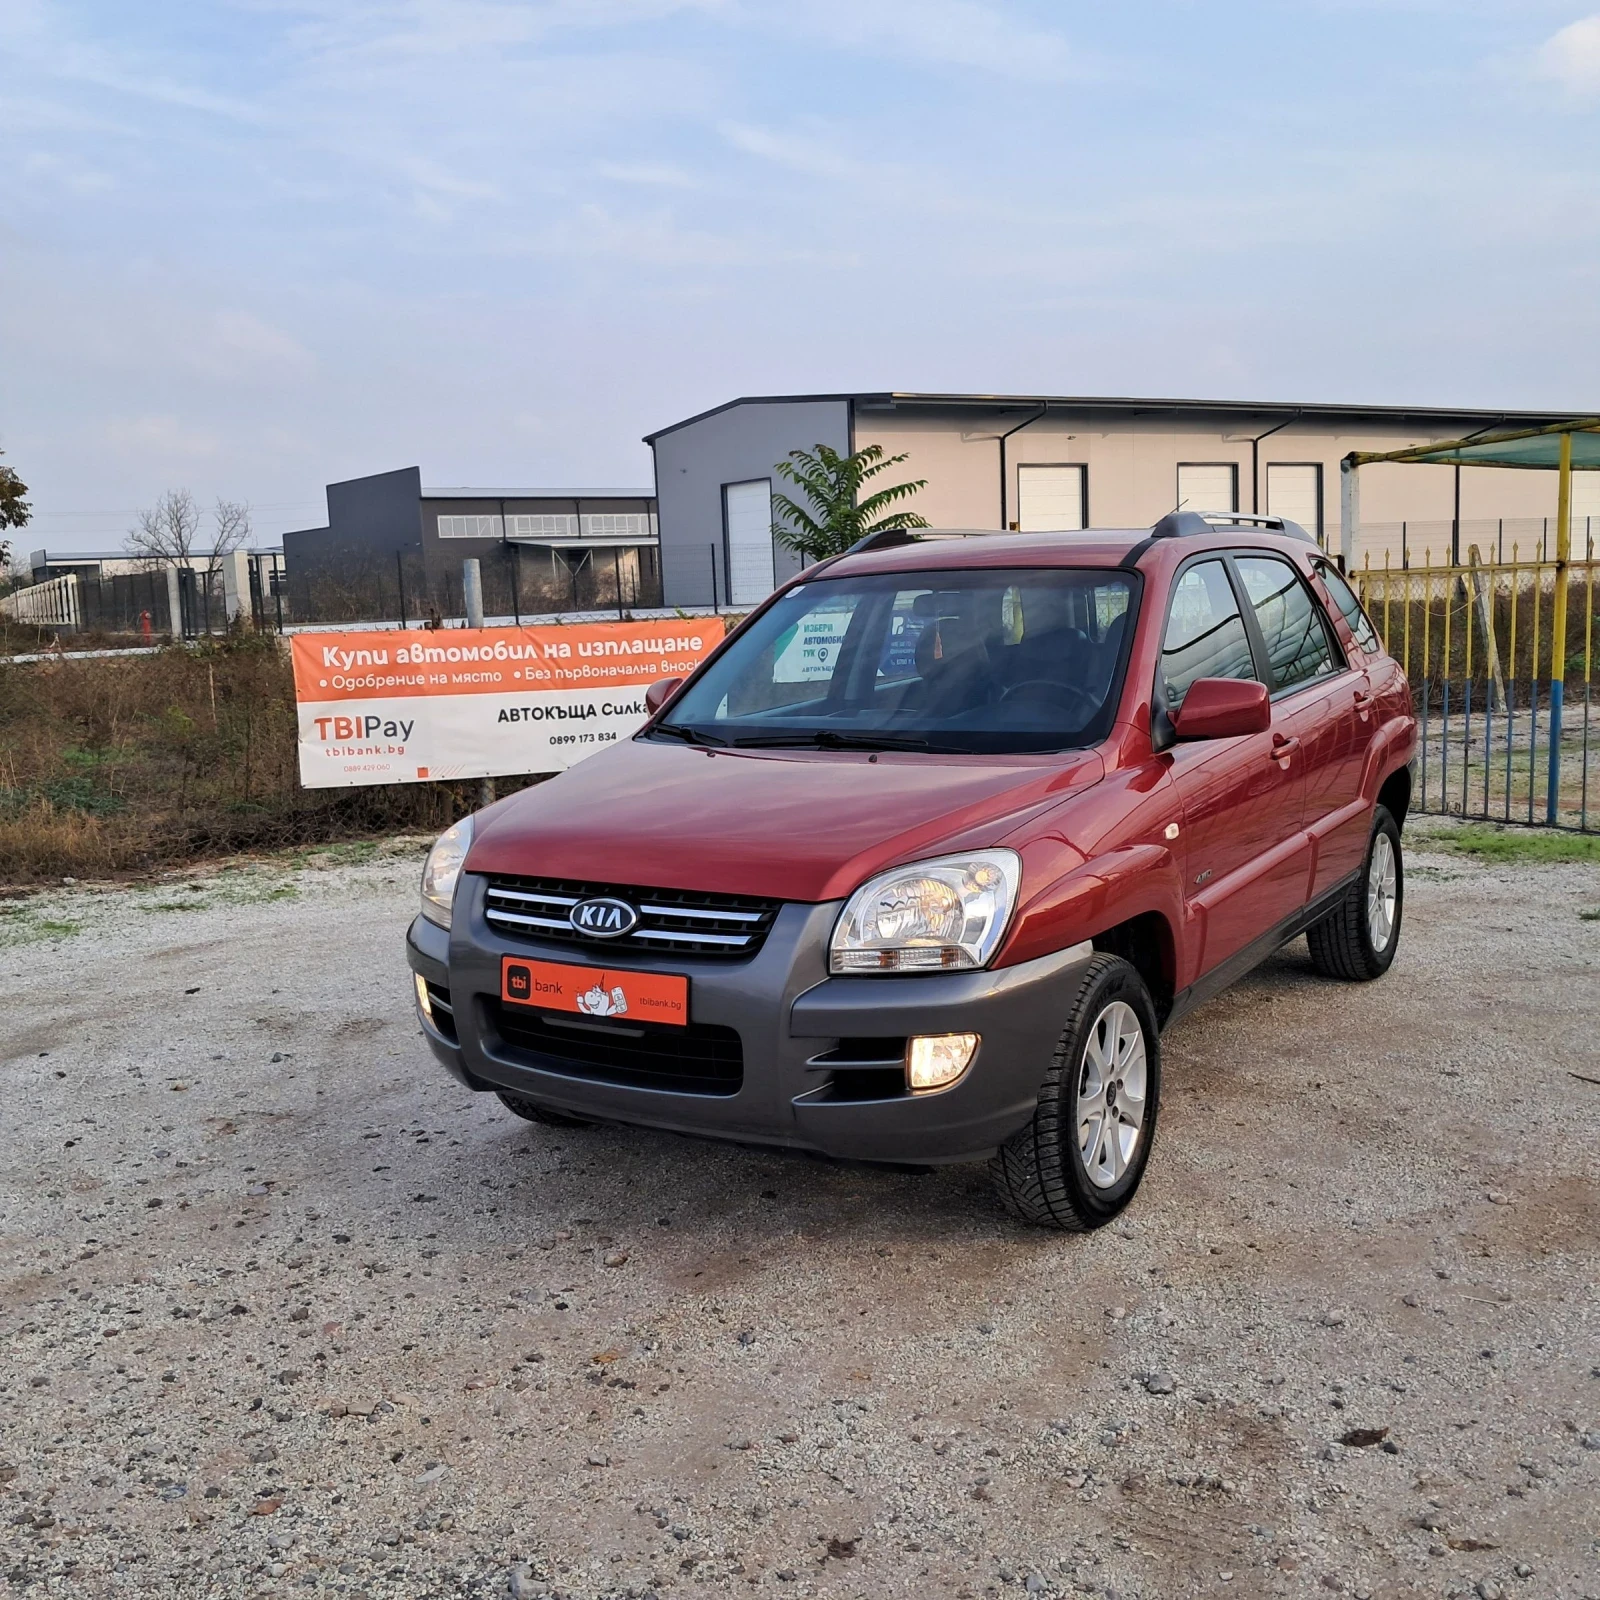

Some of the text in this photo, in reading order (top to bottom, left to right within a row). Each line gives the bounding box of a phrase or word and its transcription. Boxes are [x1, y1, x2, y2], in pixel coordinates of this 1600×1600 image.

[803, 623, 833, 633] ИЗБЕРИ
[322, 635, 703, 671] Купи автомобил на изплащане
[803, 649, 815, 658] ТУК
[332, 671, 502, 691] Одобрение на място
[525, 666, 551, 680] Без
[555, 662, 657, 681] първоначална
[498, 703, 597, 722] АВТОКЪЩА
[314, 715, 415, 742] TBIPay
[549, 731, 617, 745] 0899 173 834
[326, 744, 405, 757] tbibank.bg
[343, 763, 391, 773] 0889 429 060
[580, 905, 622, 929] KIA
[511, 975, 563, 995] tbi bank
[639, 997, 682, 1010] tbibank.bg
